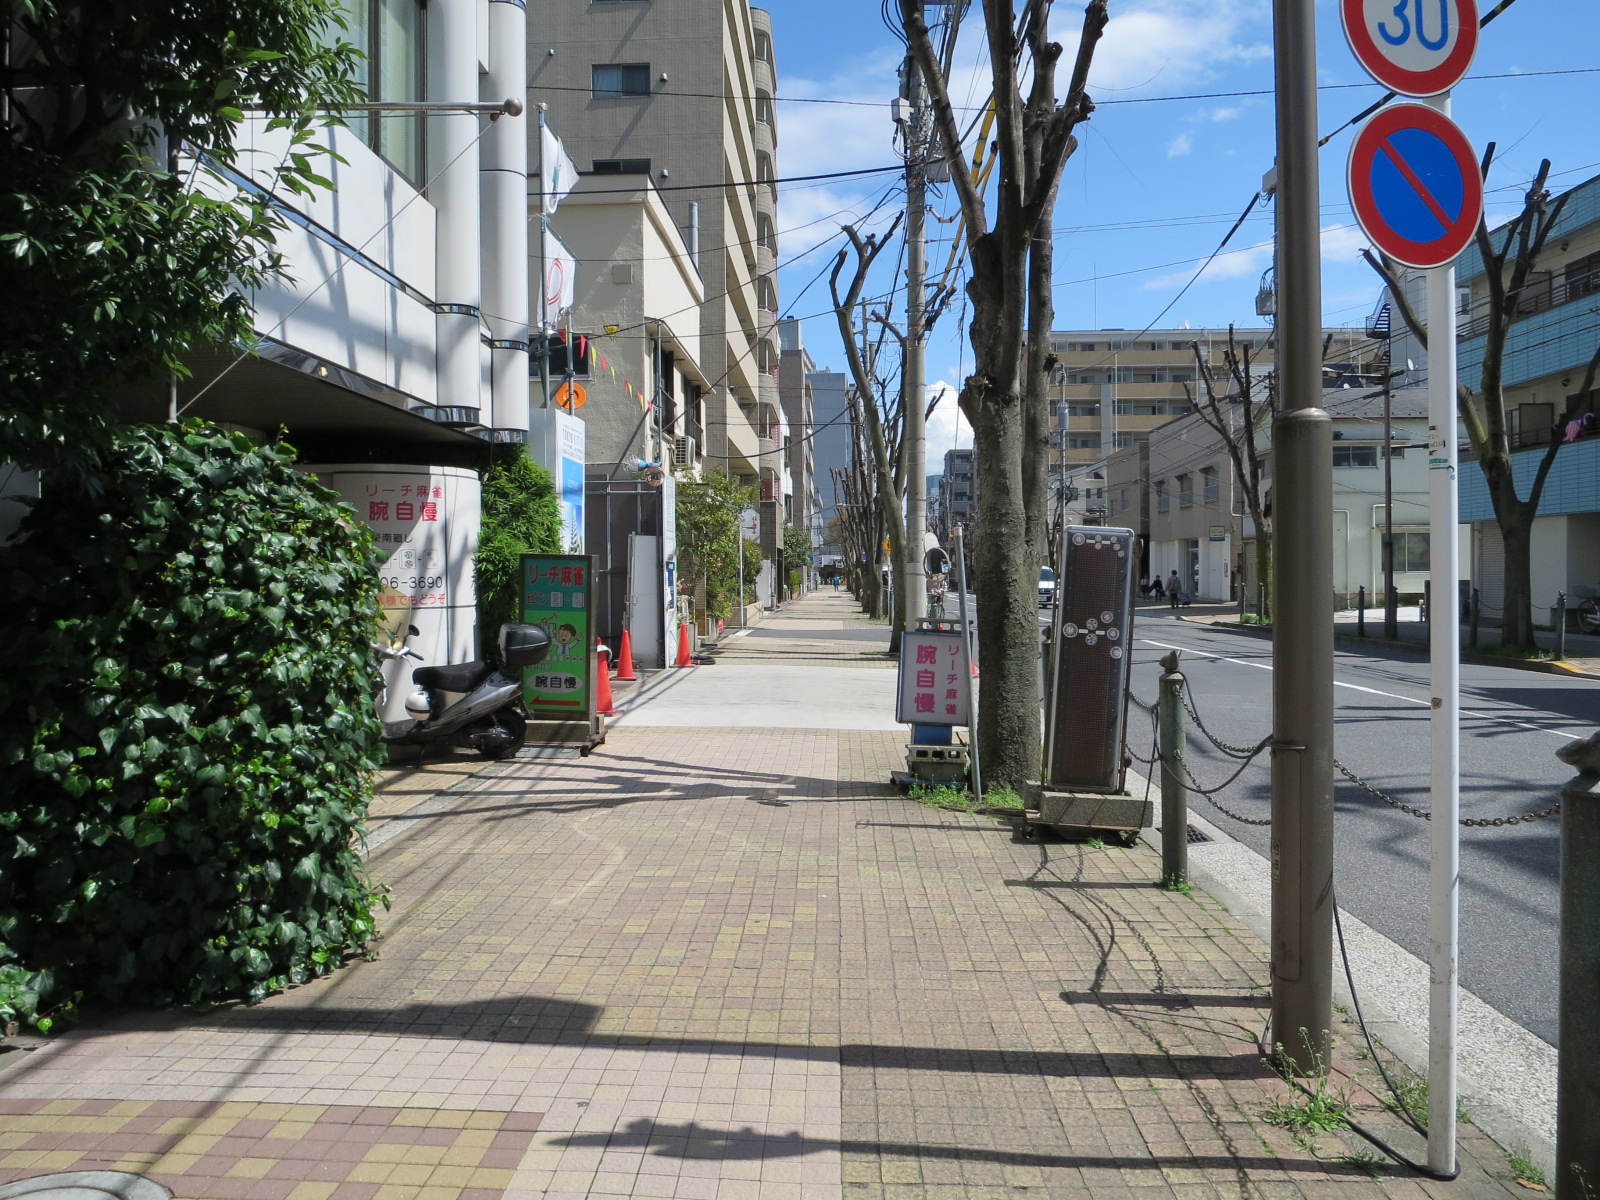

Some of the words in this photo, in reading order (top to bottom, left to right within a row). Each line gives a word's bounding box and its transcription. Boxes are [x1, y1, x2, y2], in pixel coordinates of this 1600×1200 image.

[1377, 0, 1449, 51] 30
[366, 483, 443, 498] リーチ麻雀
[369, 501, 438, 522] 腕自慢
[528, 564, 585, 586] リーチ麻雀
[535, 676, 577, 689] 腕自慢
[914, 645, 937, 713] 腕自慢
[945, 645, 959, 715] リーチ麻雀
